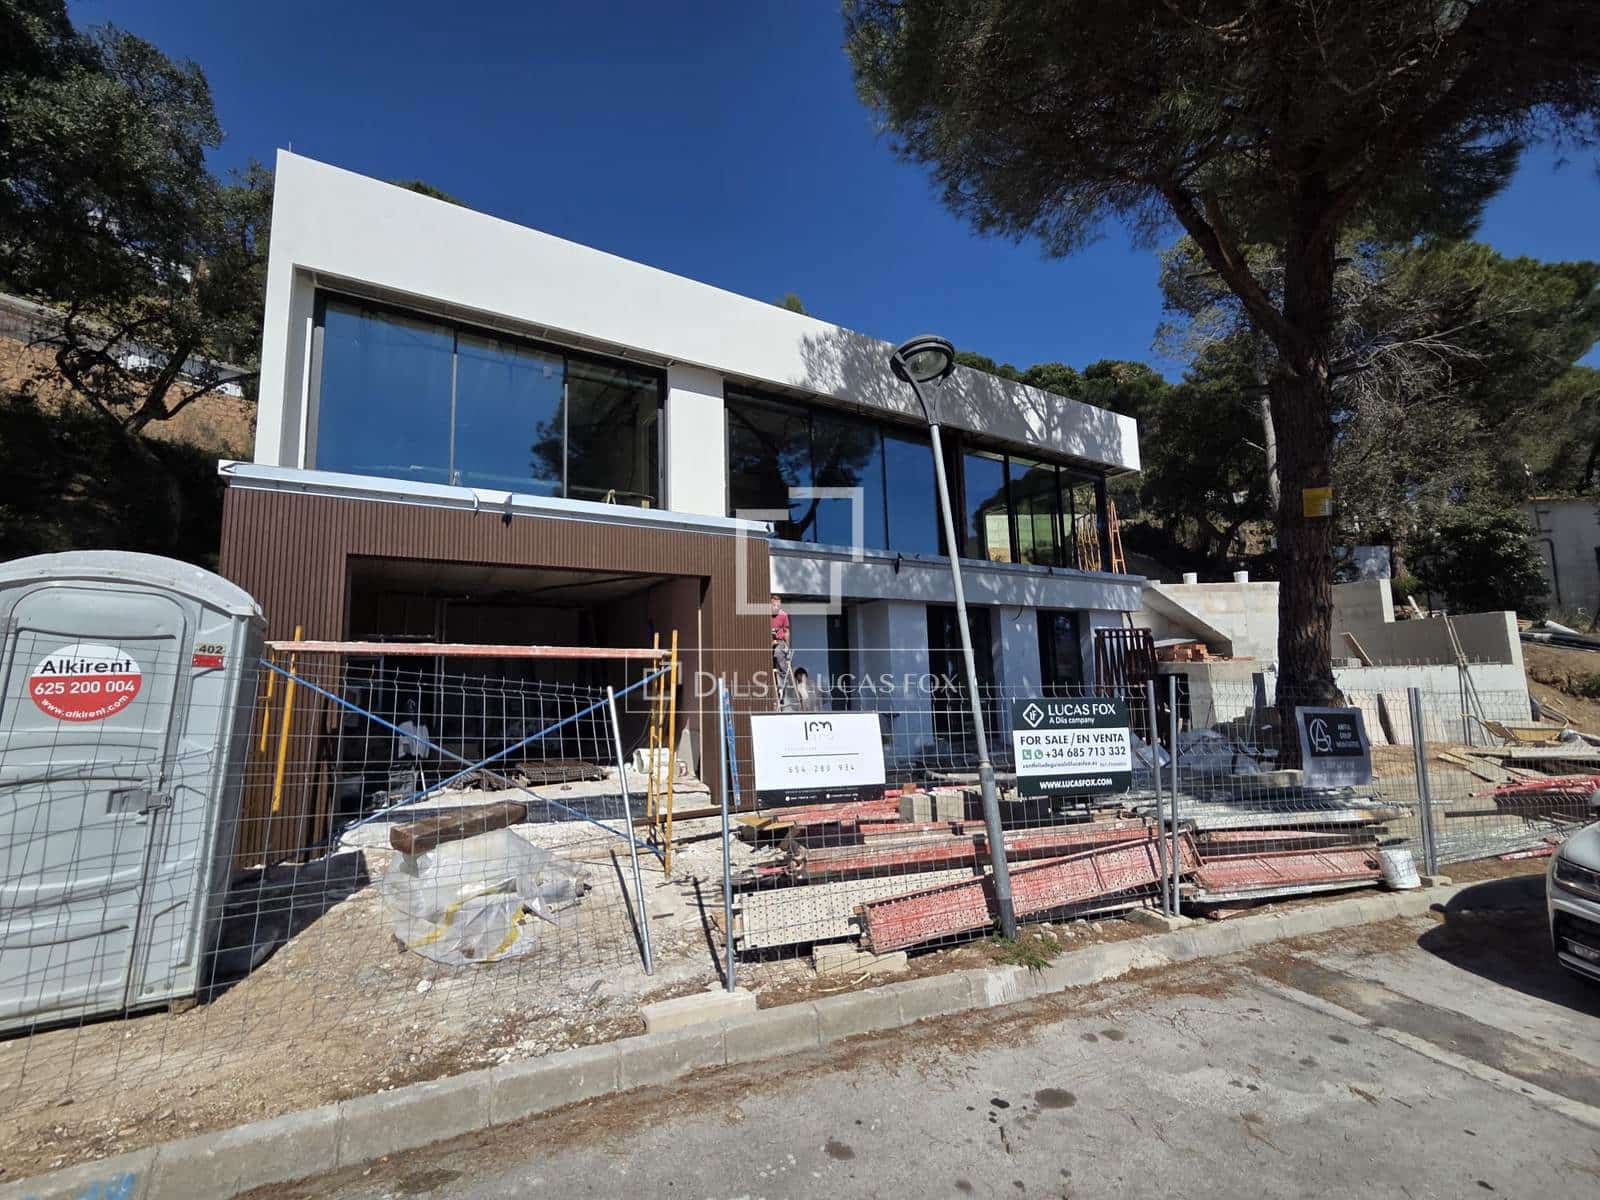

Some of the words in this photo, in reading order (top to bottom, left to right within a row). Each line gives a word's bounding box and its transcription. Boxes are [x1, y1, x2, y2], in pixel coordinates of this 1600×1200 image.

[199, 644, 224, 654] 402
[40, 659, 132, 674] Alkirent
[34, 682, 65, 695] 625
[70, 681, 100, 694] 200
[105, 680, 135, 692] 004
[41, 695, 129, 719] www.alkirent.com
[1048, 703, 1090, 716] LUCAS
[1092, 703, 1116, 715] FOX
[1068, 717, 1095, 725] company
[1020, 736, 1041, 745] FOR
[1045, 735, 1069, 745] SALE
[1076, 734, 1090, 743] EN
[1093, 733, 1125, 742] VENTA
[1046, 747, 1064, 759] +34
[1067, 747, 1085, 758] 685
[1088, 746, 1106, 756] 713
[1109, 745, 1126, 756] 332
[1039, 777, 1113, 790] WWW.LUCASFOX.COM
